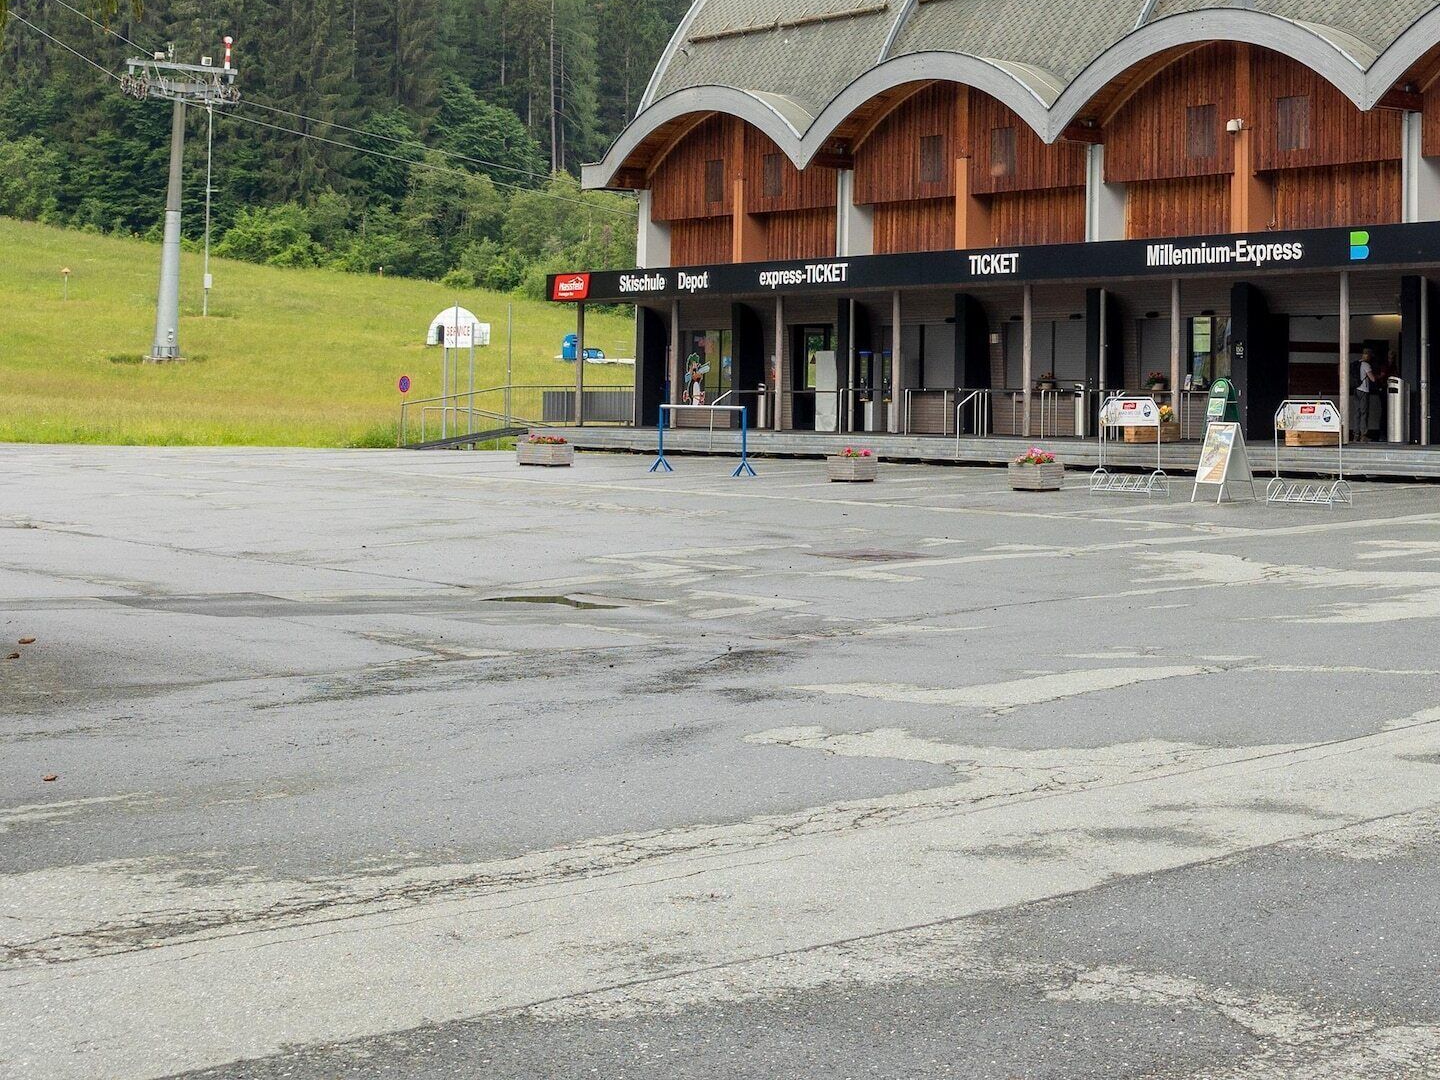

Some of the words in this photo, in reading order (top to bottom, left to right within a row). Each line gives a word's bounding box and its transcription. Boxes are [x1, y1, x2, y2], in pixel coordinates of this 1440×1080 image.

[968, 253, 1019, 275] TICKET
[1146, 239, 1303, 267] Millennium-Express
[619, 273, 666, 293] Skischule
[677, 270, 709, 294] Depot
[759, 262, 849, 290] express-TICKET
